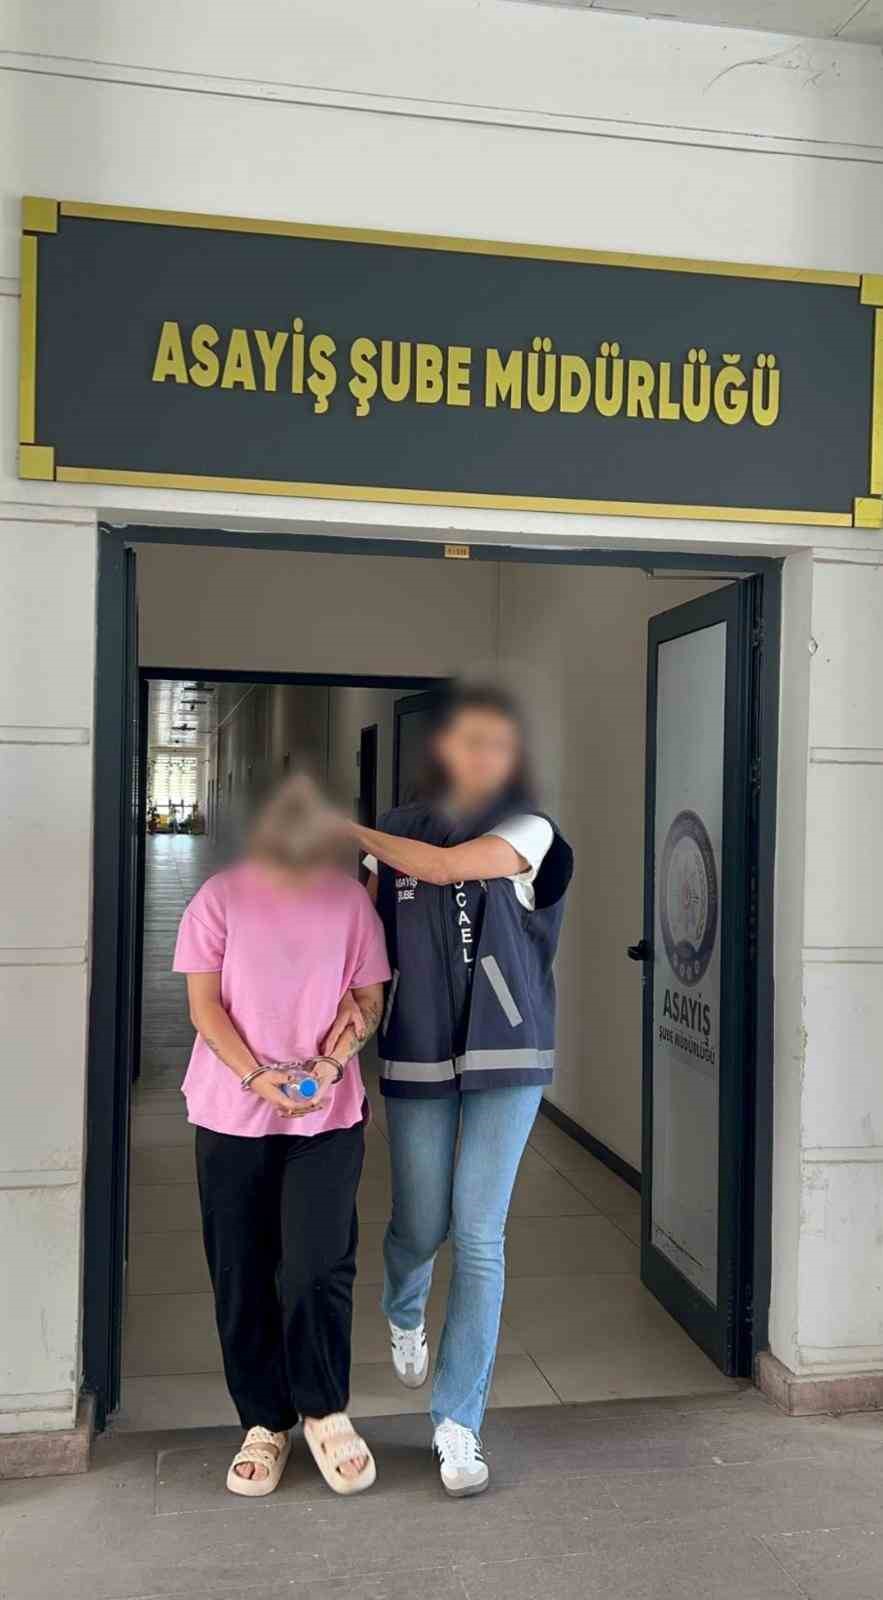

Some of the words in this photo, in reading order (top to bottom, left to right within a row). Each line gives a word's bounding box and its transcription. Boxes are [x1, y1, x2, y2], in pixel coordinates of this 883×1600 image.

[152, 318, 337, 414] ASAYİŞ
[348, 338, 473, 417] ŞUBE
[485, 337, 781, 428] MÜDÜRLÜĞÜ
[663, 988, 711, 1047] ASAYİŞ
